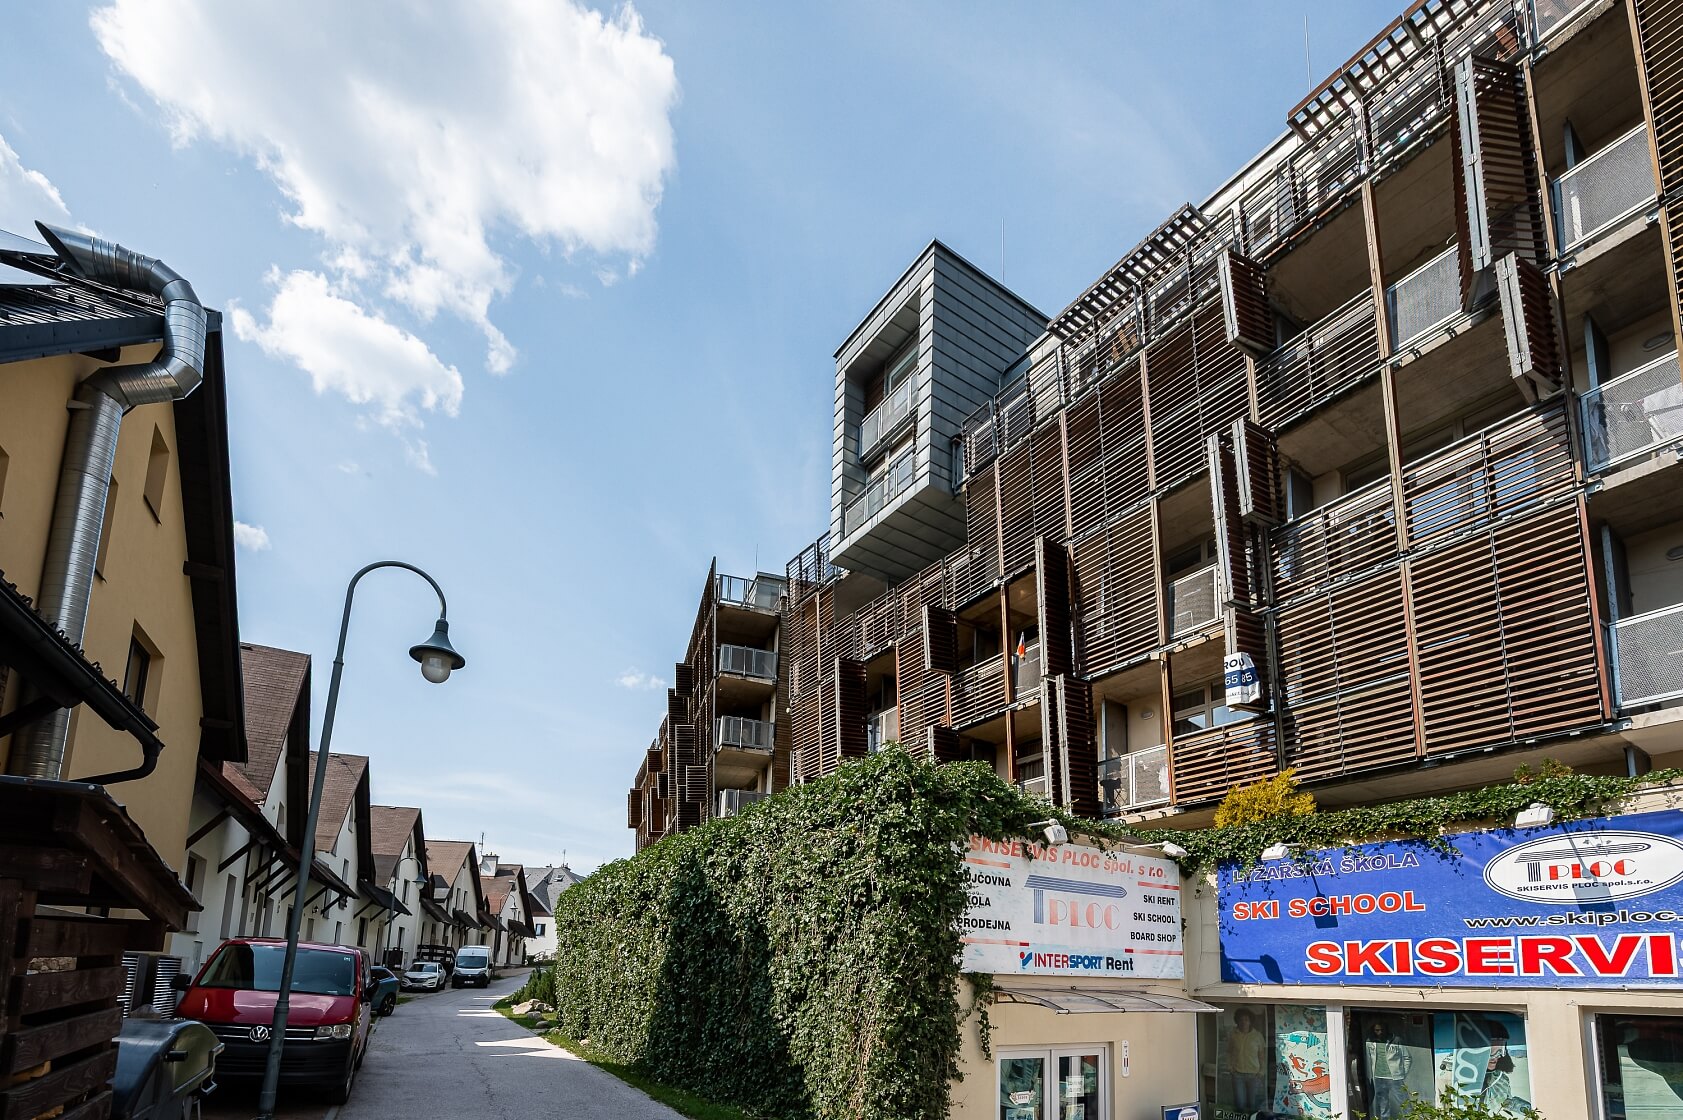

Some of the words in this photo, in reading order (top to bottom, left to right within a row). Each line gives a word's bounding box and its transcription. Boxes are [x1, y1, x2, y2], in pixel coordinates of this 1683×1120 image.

[1062, 849, 1100, 869] PLOC
[1104, 859, 1134, 875] spol.
[1138, 865, 1146, 876] s
[1341, 853, 1419, 873] ŠKOLA
[1548, 858, 1638, 881] PLOC
[965, 871, 1011, 888] JČOVNA
[1517, 884, 1569, 892] SKISERVIS
[1571, 880, 1600, 890] PLOC
[1143, 894, 1156, 904] SKI
[1157, 896, 1176, 906] RENT
[1233, 900, 1279, 920] SKI
[1288, 891, 1425, 917] SCHOOL
[957, 917, 1012, 931] PRODEJNA
[1049, 898, 1121, 931] PLOC
[1133, 911, 1146, 922] SKI
[1147, 913, 1176, 924] SCHOOL
[1130, 931, 1155, 942] BOARD
[1157, 934, 1177, 943] SHOP
[1033, 951, 1103, 970] INTERSPORT
[1105, 956, 1134, 971] Rent
[1306, 935, 1683, 977] SKISERVI
